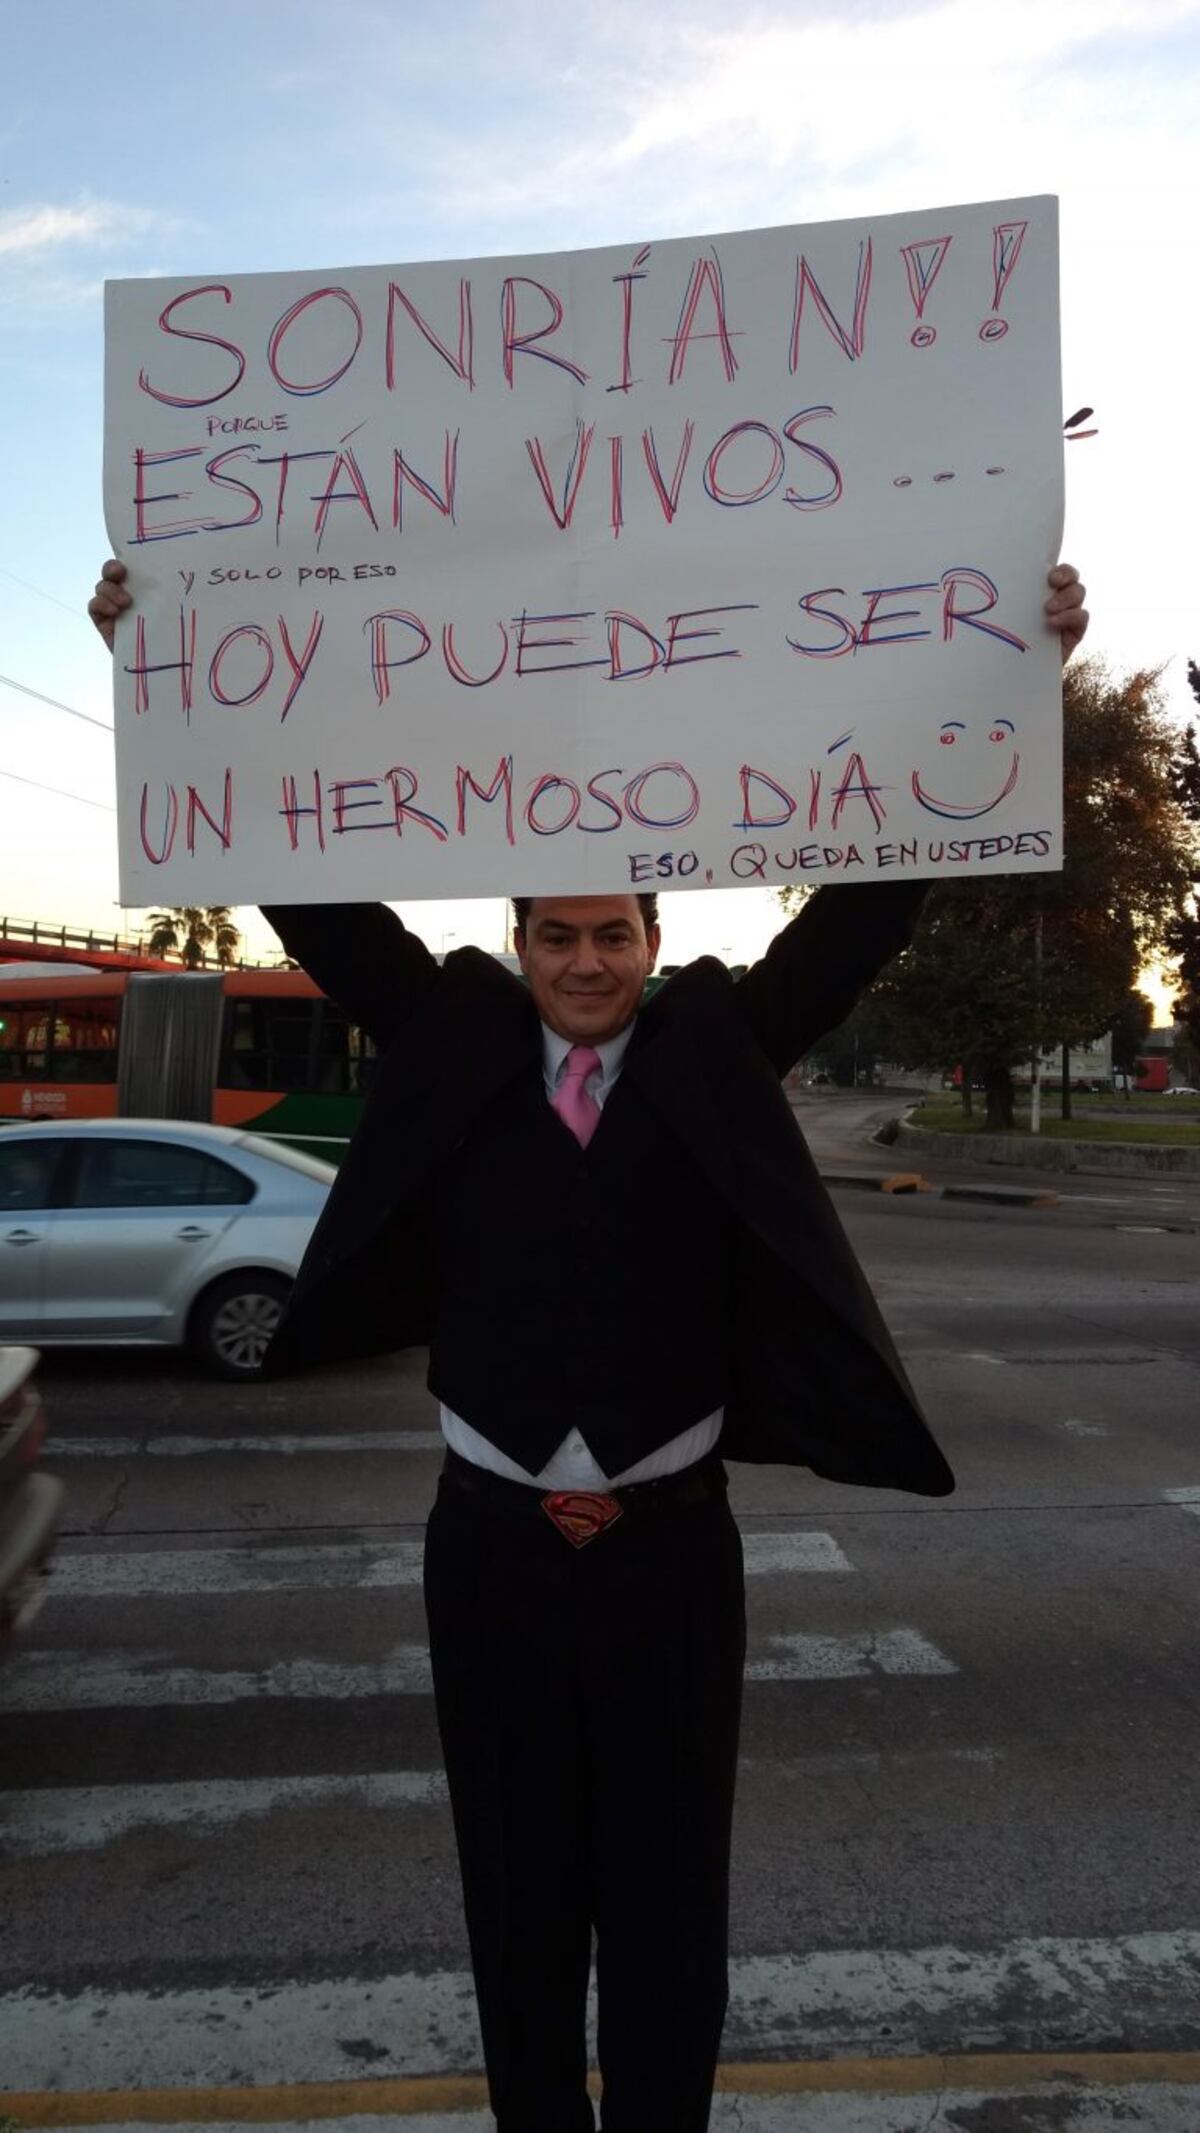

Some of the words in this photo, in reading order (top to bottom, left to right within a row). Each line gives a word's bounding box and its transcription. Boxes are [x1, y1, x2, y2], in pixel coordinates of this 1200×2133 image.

[205, 413, 289, 437] PORQUE
[127, 416, 460, 553] ESTÁN
[207, 566, 283, 586] SOLO
[298, 565, 347, 588] POR
[353, 563, 398, 580] ESO
[124, 603, 324, 727] HOY
[362, 603, 760, 706] PUEDE
[785, 567, 1032, 659] SER
[139, 766, 232, 865] UN
[278, 753, 700, 855] HERMOSO
[732, 728, 898, 835] DÍA
[729, 842, 865, 881] QUEDA
[876, 838, 918, 868] EN
[928, 830, 1053, 863] USTEDES
